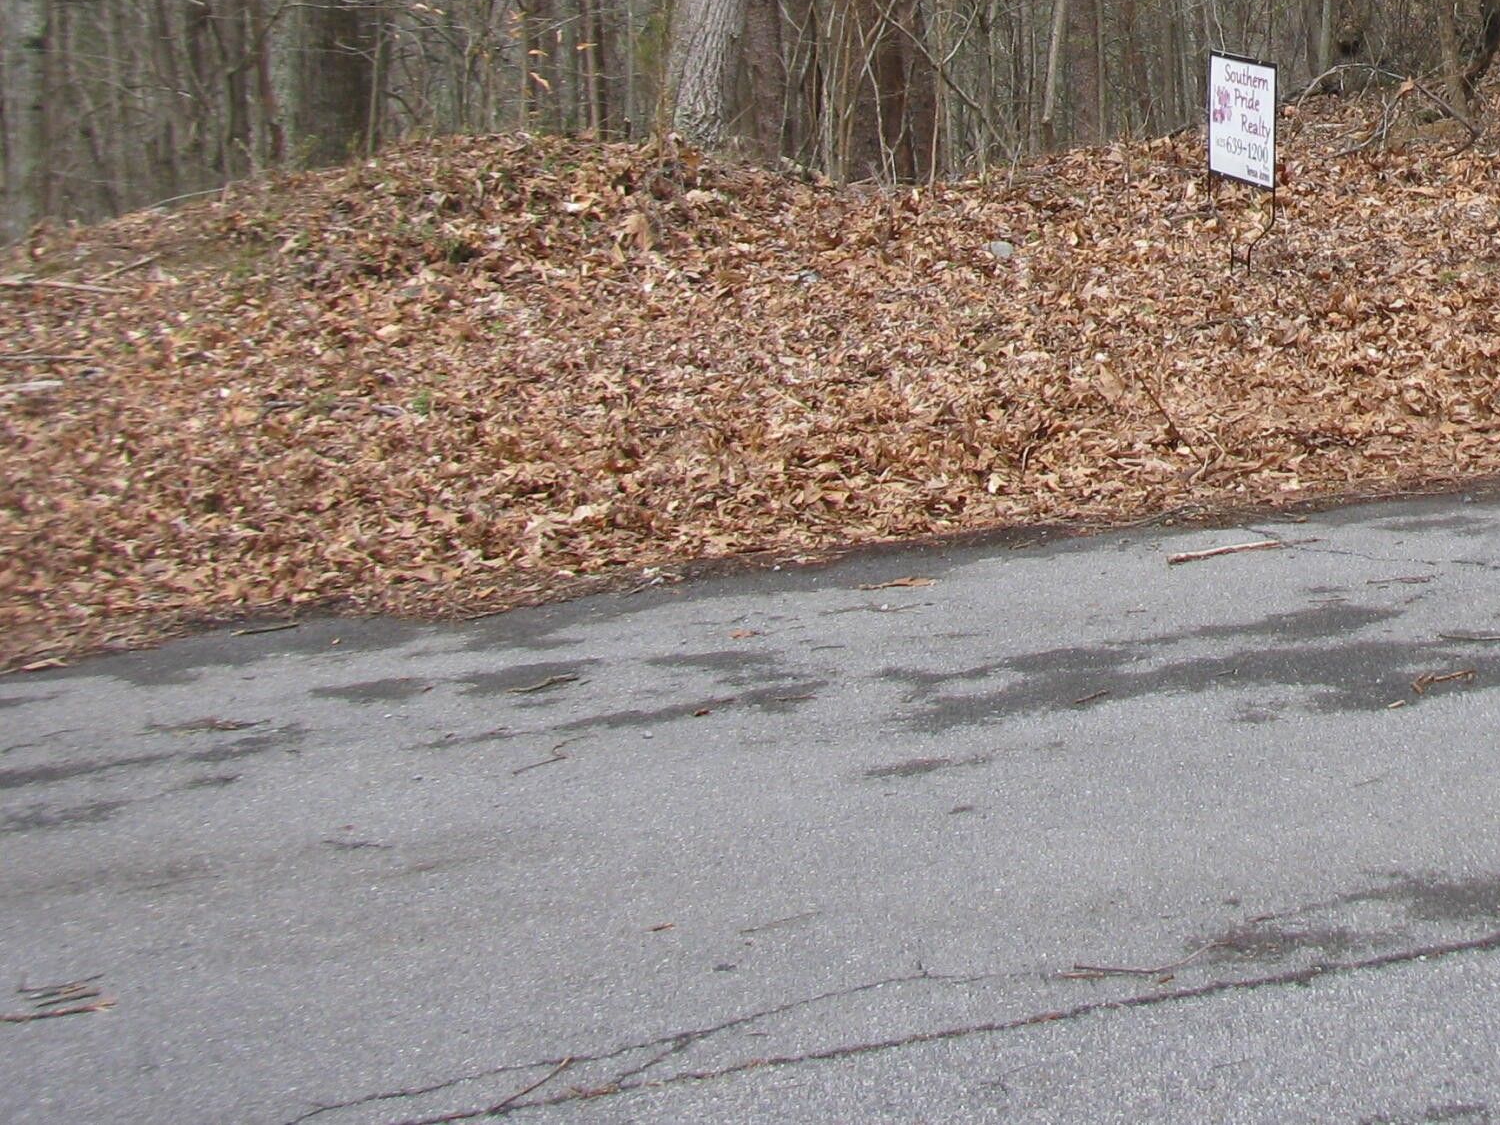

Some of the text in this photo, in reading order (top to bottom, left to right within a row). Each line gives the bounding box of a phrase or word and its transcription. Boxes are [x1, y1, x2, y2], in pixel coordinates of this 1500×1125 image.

[1225, 63, 1269, 91] Southern
[1234, 88, 1260, 112] Pride
[1241, 113, 1271, 144] Realty
[1226, 136, 1269, 164] 639-1200
